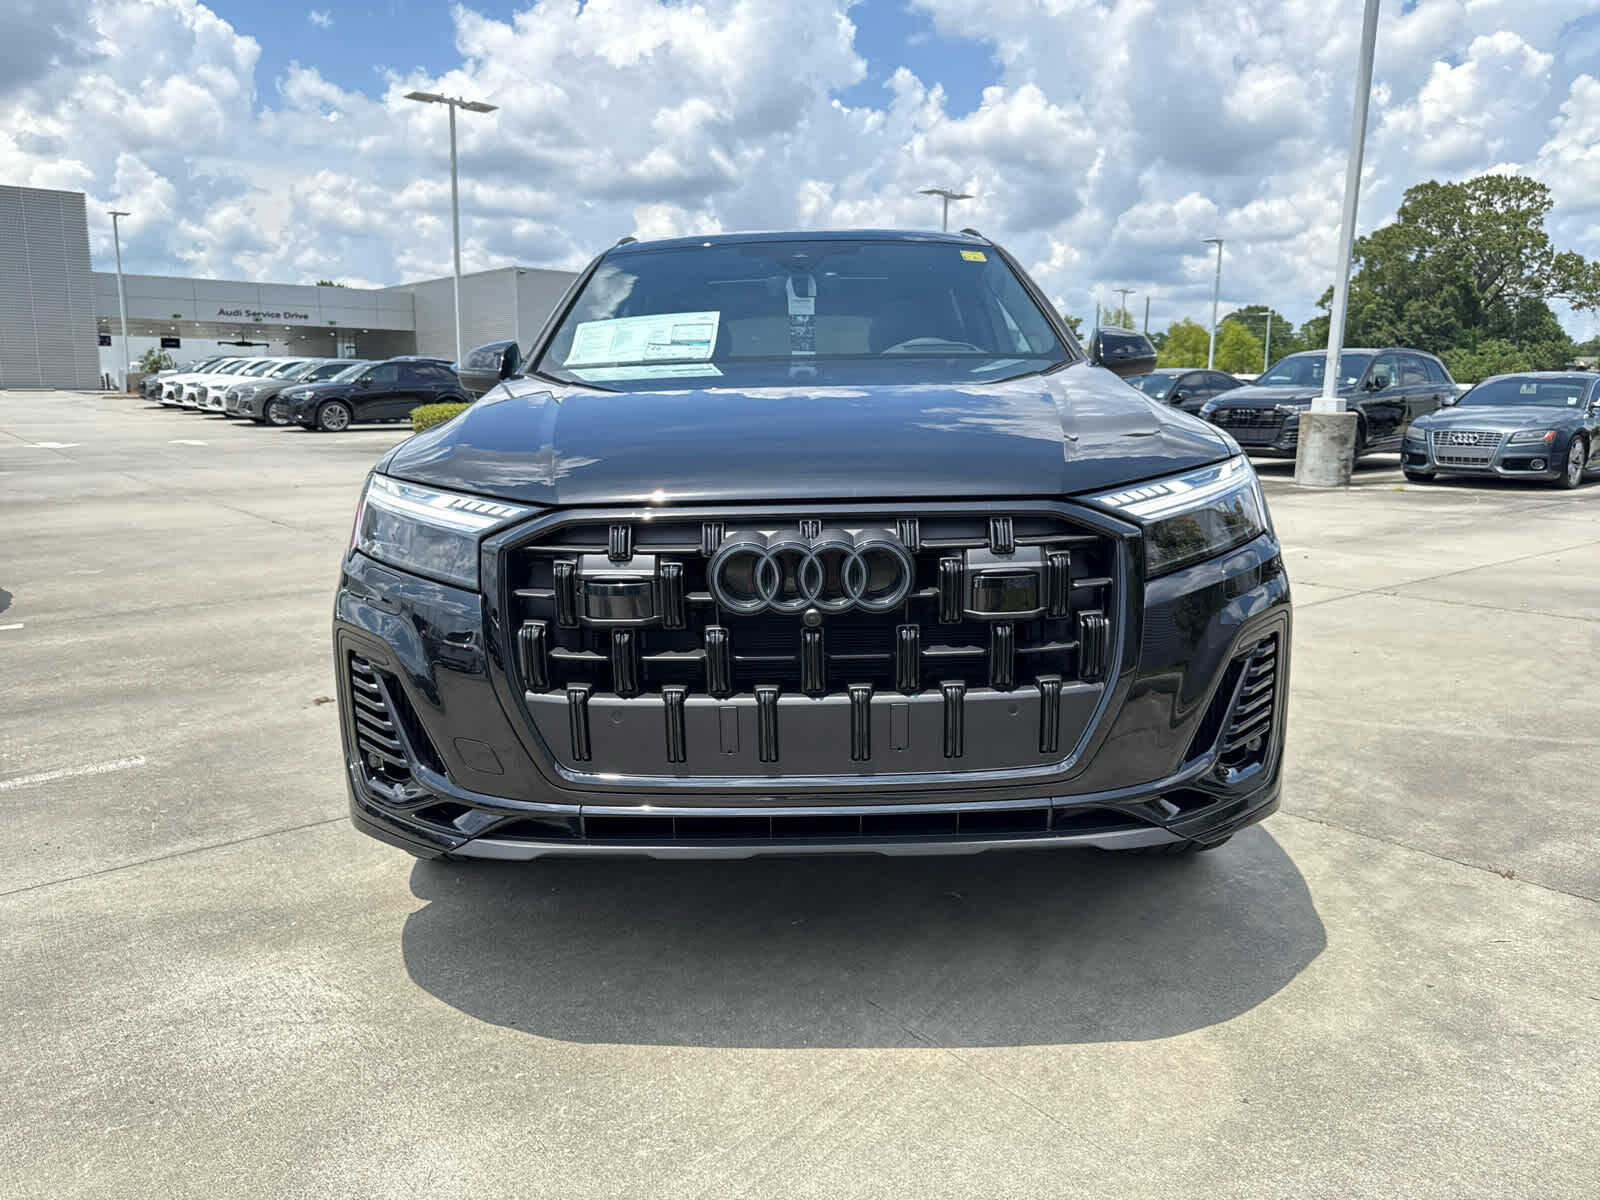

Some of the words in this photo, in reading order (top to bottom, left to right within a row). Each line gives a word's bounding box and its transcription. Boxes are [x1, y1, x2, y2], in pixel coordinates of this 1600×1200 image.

[218, 308, 242, 316] Audi
[244, 309, 281, 318] Service
[283, 311, 309, 319] Drive
